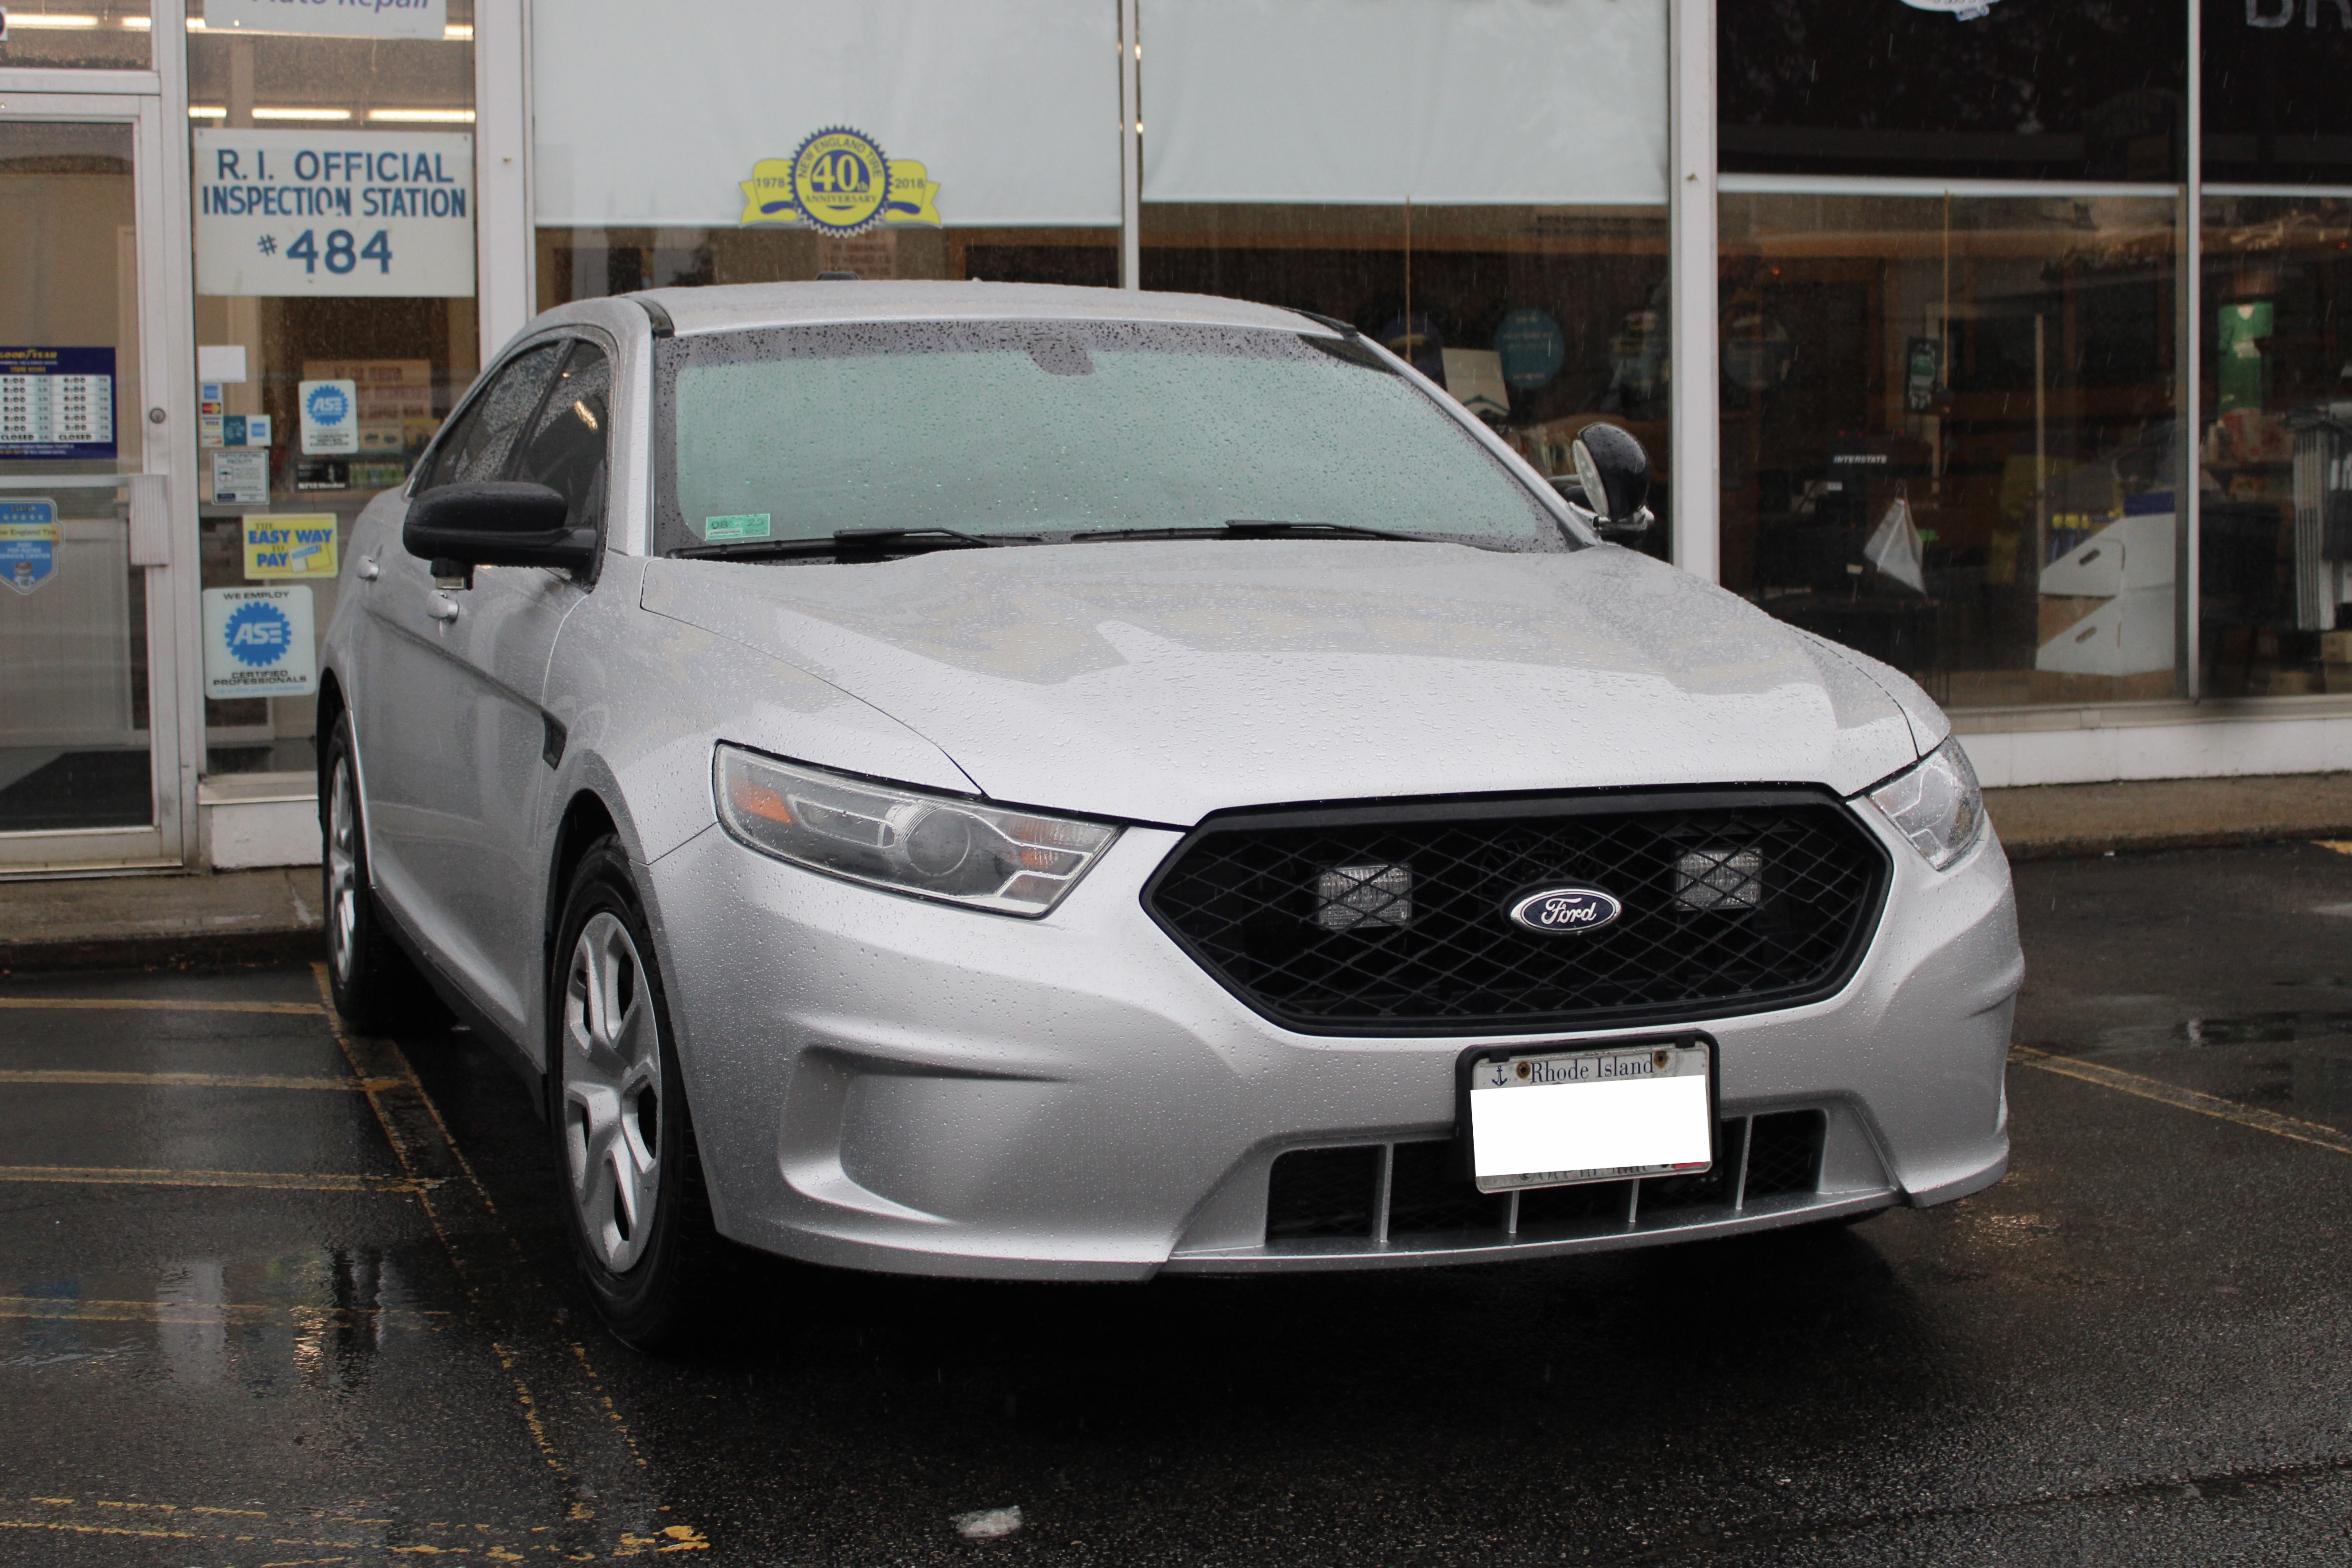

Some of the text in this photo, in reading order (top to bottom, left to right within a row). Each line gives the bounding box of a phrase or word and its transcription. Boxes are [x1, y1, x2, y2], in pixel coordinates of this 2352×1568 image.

[798, 136, 883, 178] NEW ENGLAND TIRE
[294, 151, 454, 182] OFFICIAL
[757, 178, 786, 188] 1978
[894, 178, 924, 189] 2018
[202, 186, 466, 218] INSPECTION STATION
[805, 194, 877, 203] ANNIVERSARY
[312, 397, 342, 412] ASE
[1834, 455, 1887, 464] INTERSTATE
[248, 529, 333, 544] EASY WAY
[257, 553, 289, 567] PAY
[233, 622, 282, 645] ASE
[213, 676, 307, 686] PROFESSIONALS
[232, 670, 288, 679] CERTIFIED
[1541, 897, 1597, 924] Ford
[1531, 1053, 1655, 1083] Rhode Island
